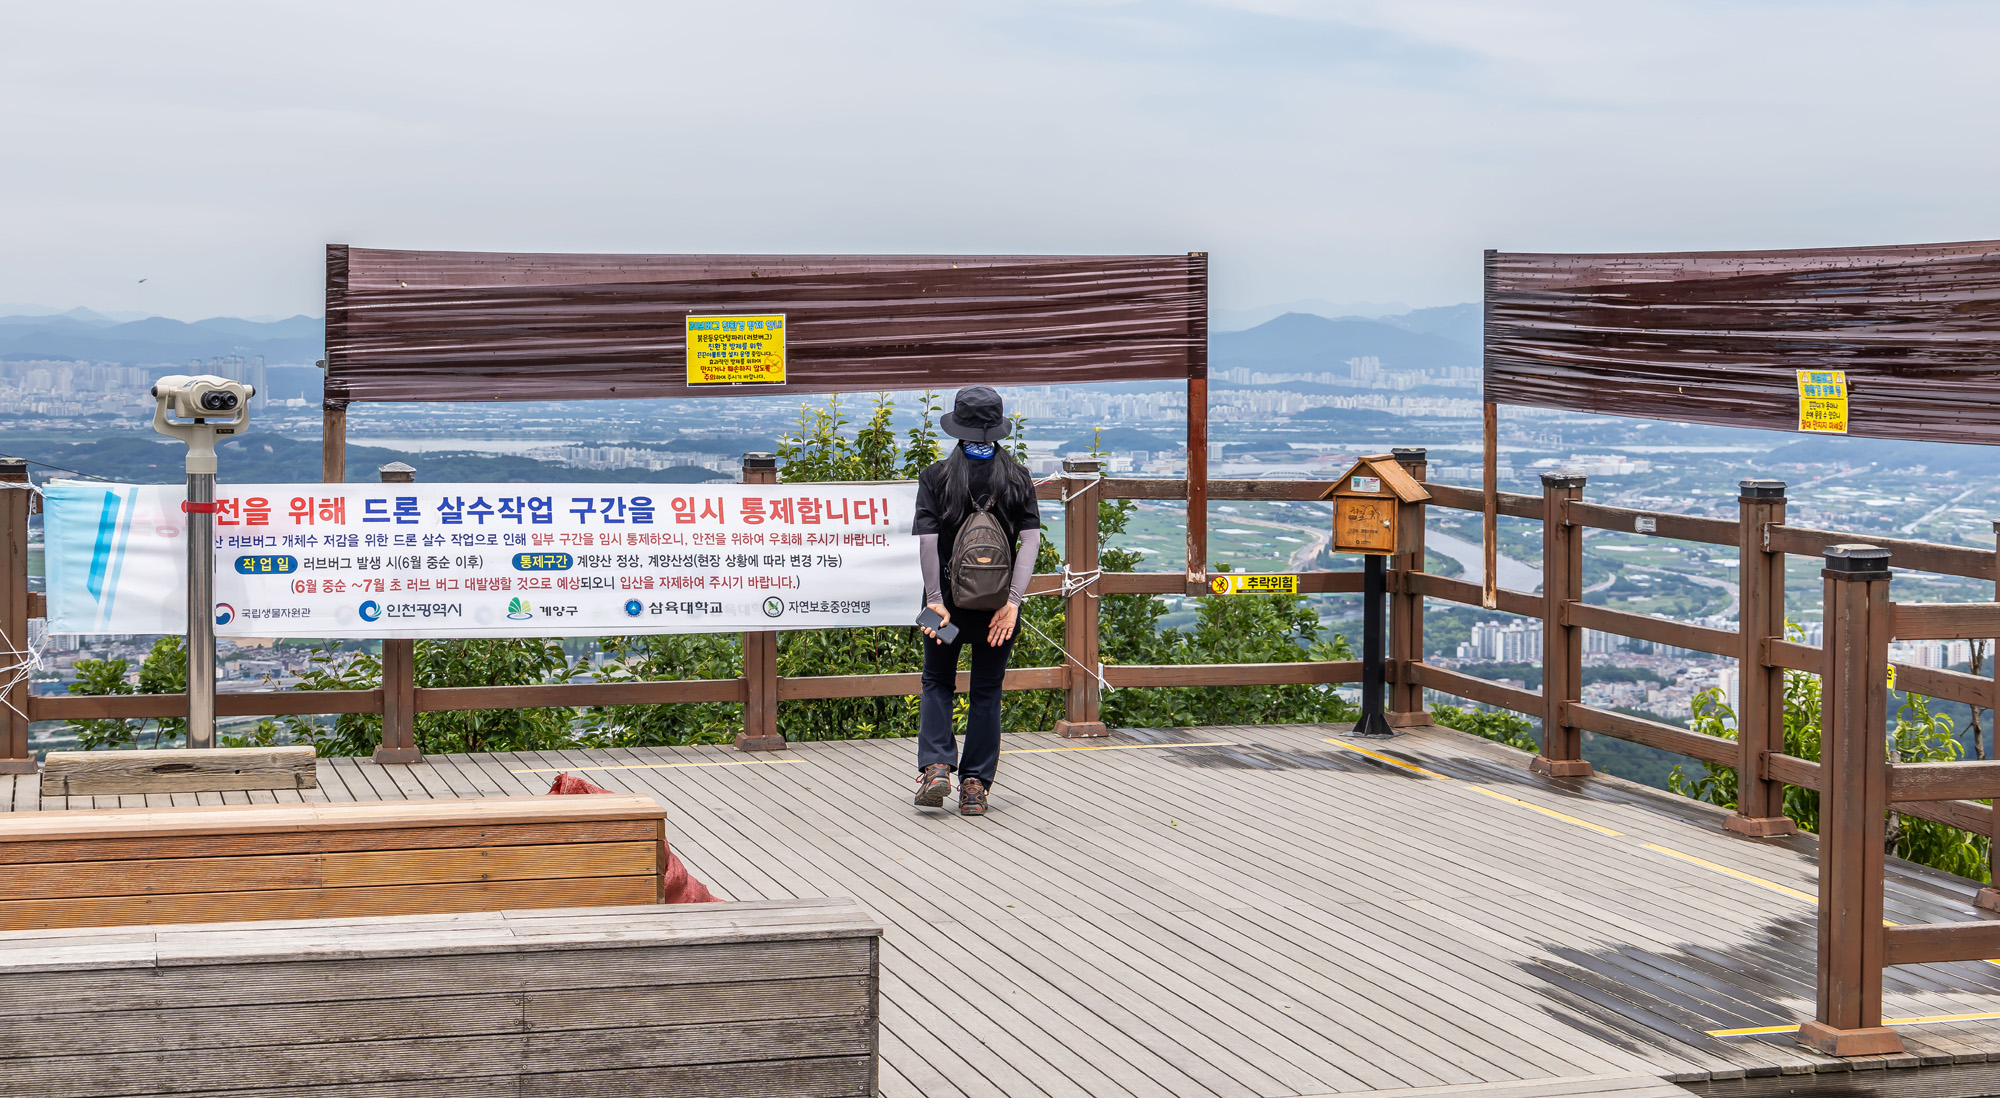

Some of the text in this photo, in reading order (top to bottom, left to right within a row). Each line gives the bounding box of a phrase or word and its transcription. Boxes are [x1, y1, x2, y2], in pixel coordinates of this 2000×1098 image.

[688, 320, 783, 331] 러브버그 친환경 방제 안내
[181, 496, 889, 526] 전을 위해 드론 살수작업 구간을 임시 통제합니다!
[229, 535, 277, 548] 러브버그
[282, 534, 318, 548] 개체수
[324, 534, 359, 547] 저감을
[365, 534, 388, 547] 위한
[393, 534, 417, 546] 드론
[422, 534, 446, 546] 살수
[451, 533, 498, 546] 작업으로
[503, 533, 526, 546] 인해
[532, 533, 554, 546] 일부
[559, 533, 594, 545] 구간을
[599, 533, 621, 545] 임시
[627, 533, 687, 546] 통제하오니,
[693, 533, 726, 545] 안전을
[731, 533, 764, 545] 위하여
[769, 533, 802, 546] 우회해
[807, 533, 838, 546] 주시기
[844, 532, 889, 546] 바랍니다.
[304, 557, 352, 570] 러브버그
[357, 556, 380, 570] 발생
[386, 556, 421, 570] 시(6월
[427, 556, 450, 569] 중순
[456, 555, 483, 569] 이후)
[520, 554, 842, 569] 통제구간 계양산 정상, 계양산성(현장 상황에 따라 변경 가능)
[291, 575, 800, 594] (6월 중순 ~7월 초 러브 버그 대발생할 것으로 예상되오니 입산을 자제하여 주시기 바랍니다.)
[1248, 577, 1292, 588] 추락위험
[242, 608, 310, 618] 국립생물자원관
[387, 603, 461, 617] 인천광역시
[539, 606, 578, 616] 계양구
[649, 601, 723, 614] 삼육대학교
[789, 601, 870, 613] 자연보호중앙연맹
